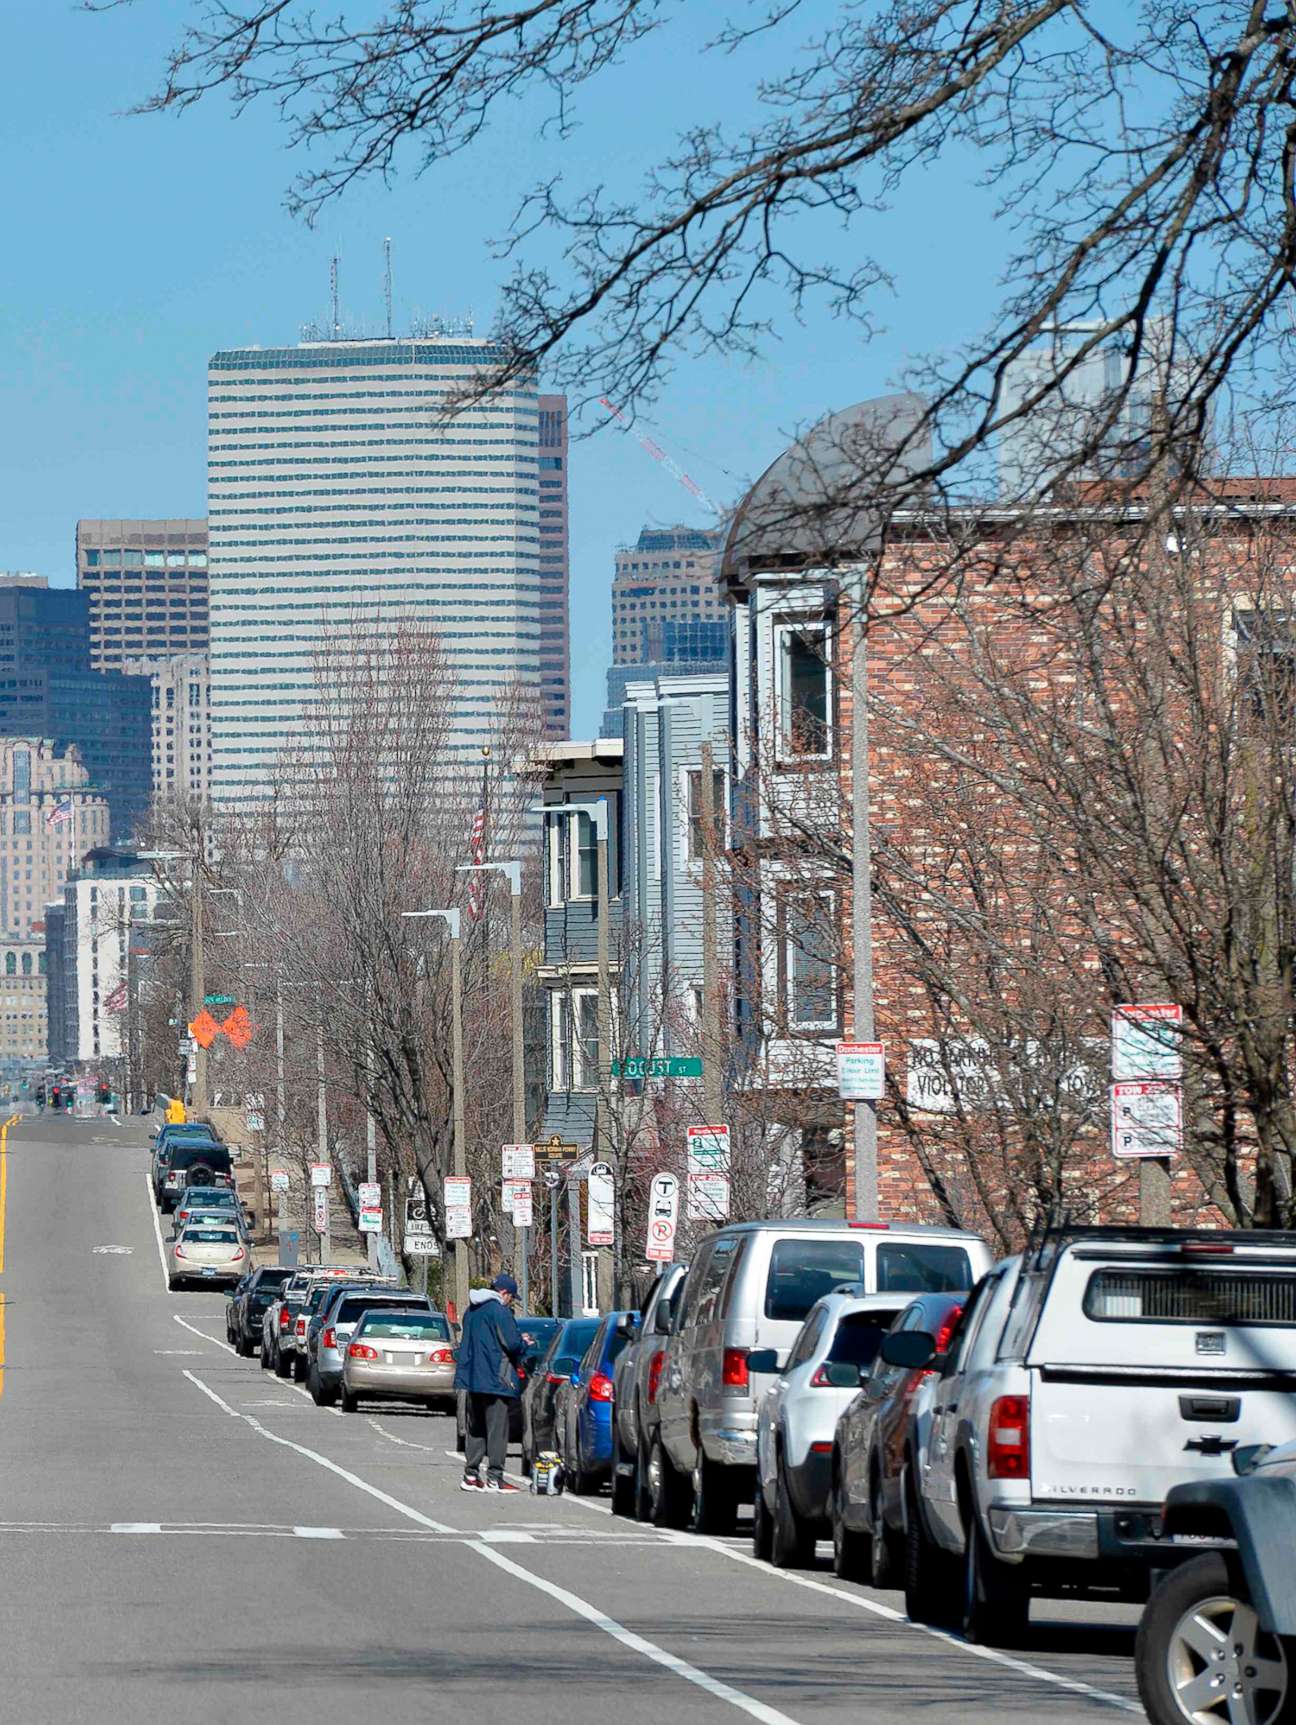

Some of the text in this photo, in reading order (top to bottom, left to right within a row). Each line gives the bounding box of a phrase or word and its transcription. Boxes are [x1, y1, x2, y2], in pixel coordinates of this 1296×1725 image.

[838, 1045, 881, 1054] Dorchester
[621, 1060, 686, 1076] OCUST ST
[917, 1074, 991, 1097] VIOLTOR
[1123, 1136, 1132, 1147] P
[658, 1181, 673, 1194] T
[414, 1241, 439, 1250] ENDS
[1045, 1485, 1137, 1496] ILVERADO
